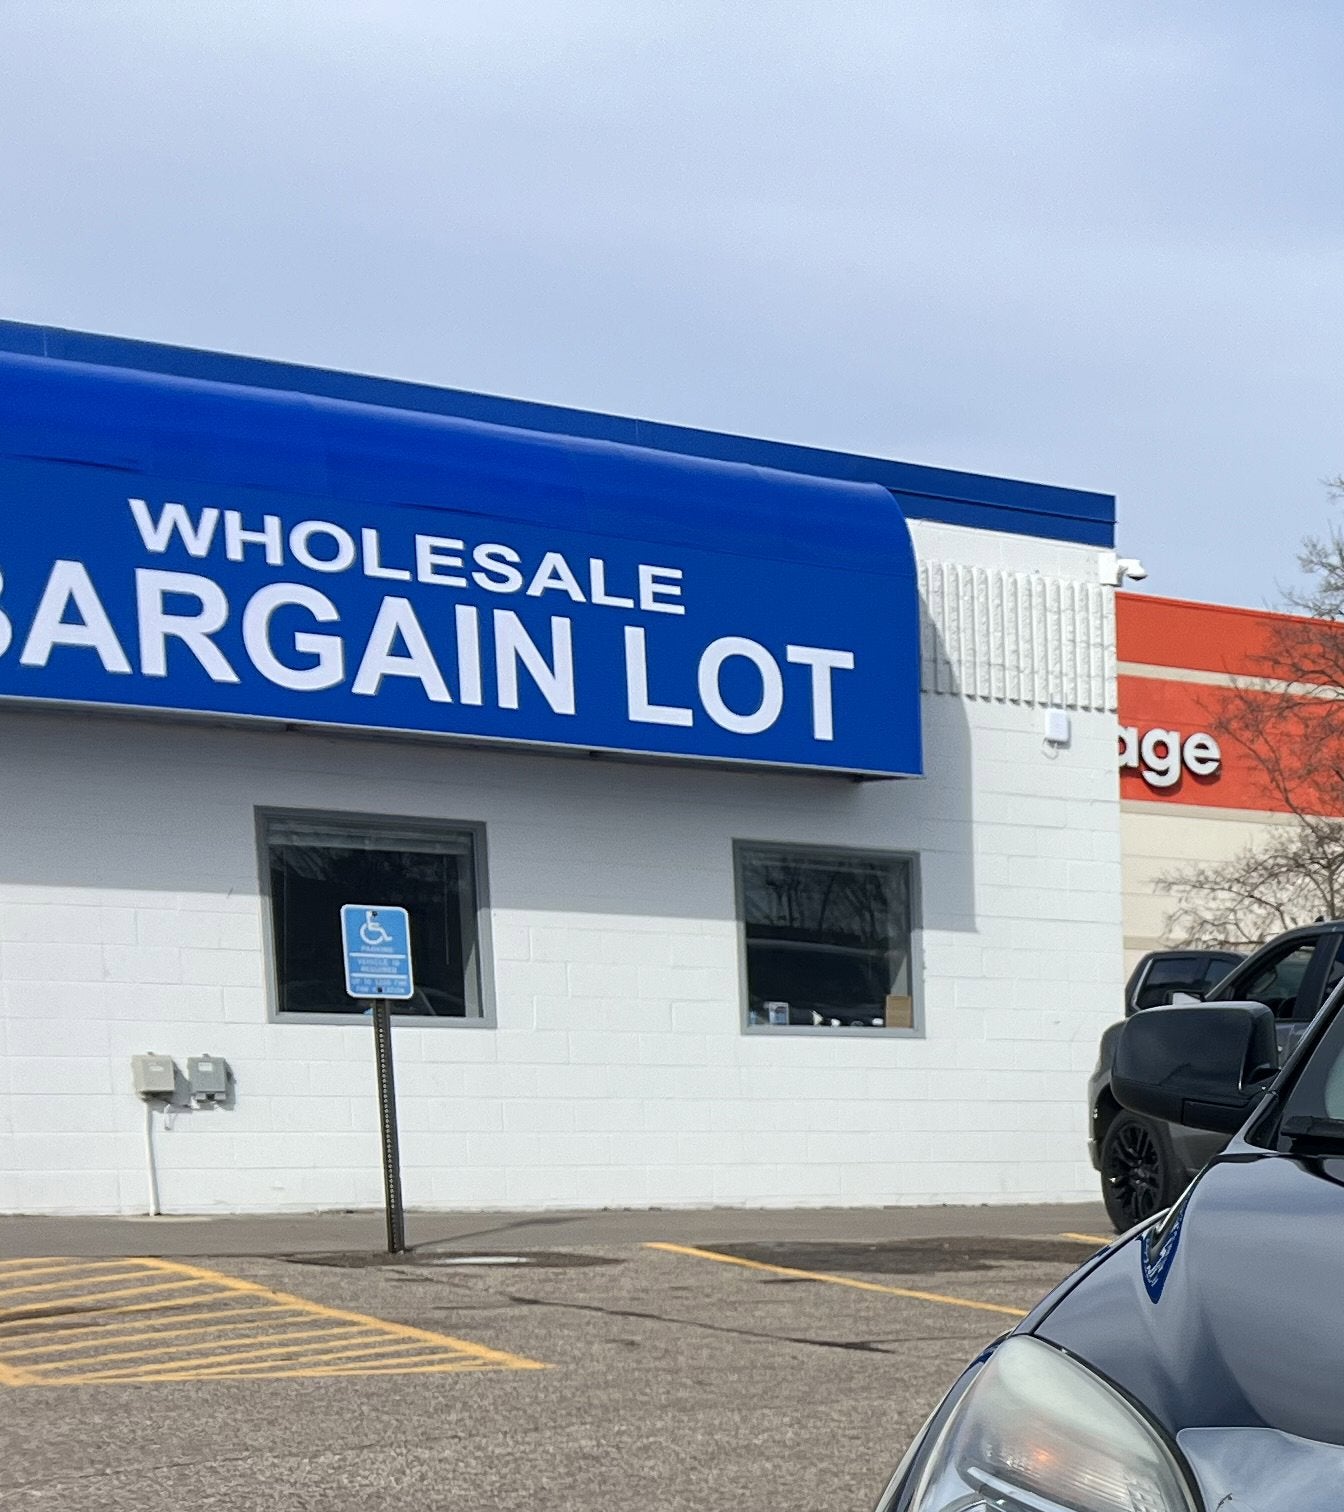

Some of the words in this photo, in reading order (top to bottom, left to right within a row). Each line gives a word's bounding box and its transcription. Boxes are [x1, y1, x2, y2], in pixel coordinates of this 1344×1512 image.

[128, 498, 686, 616] WHOLESALE
[0, 559, 577, 715] ARGAIN
[624, 626, 855, 741] LOT
